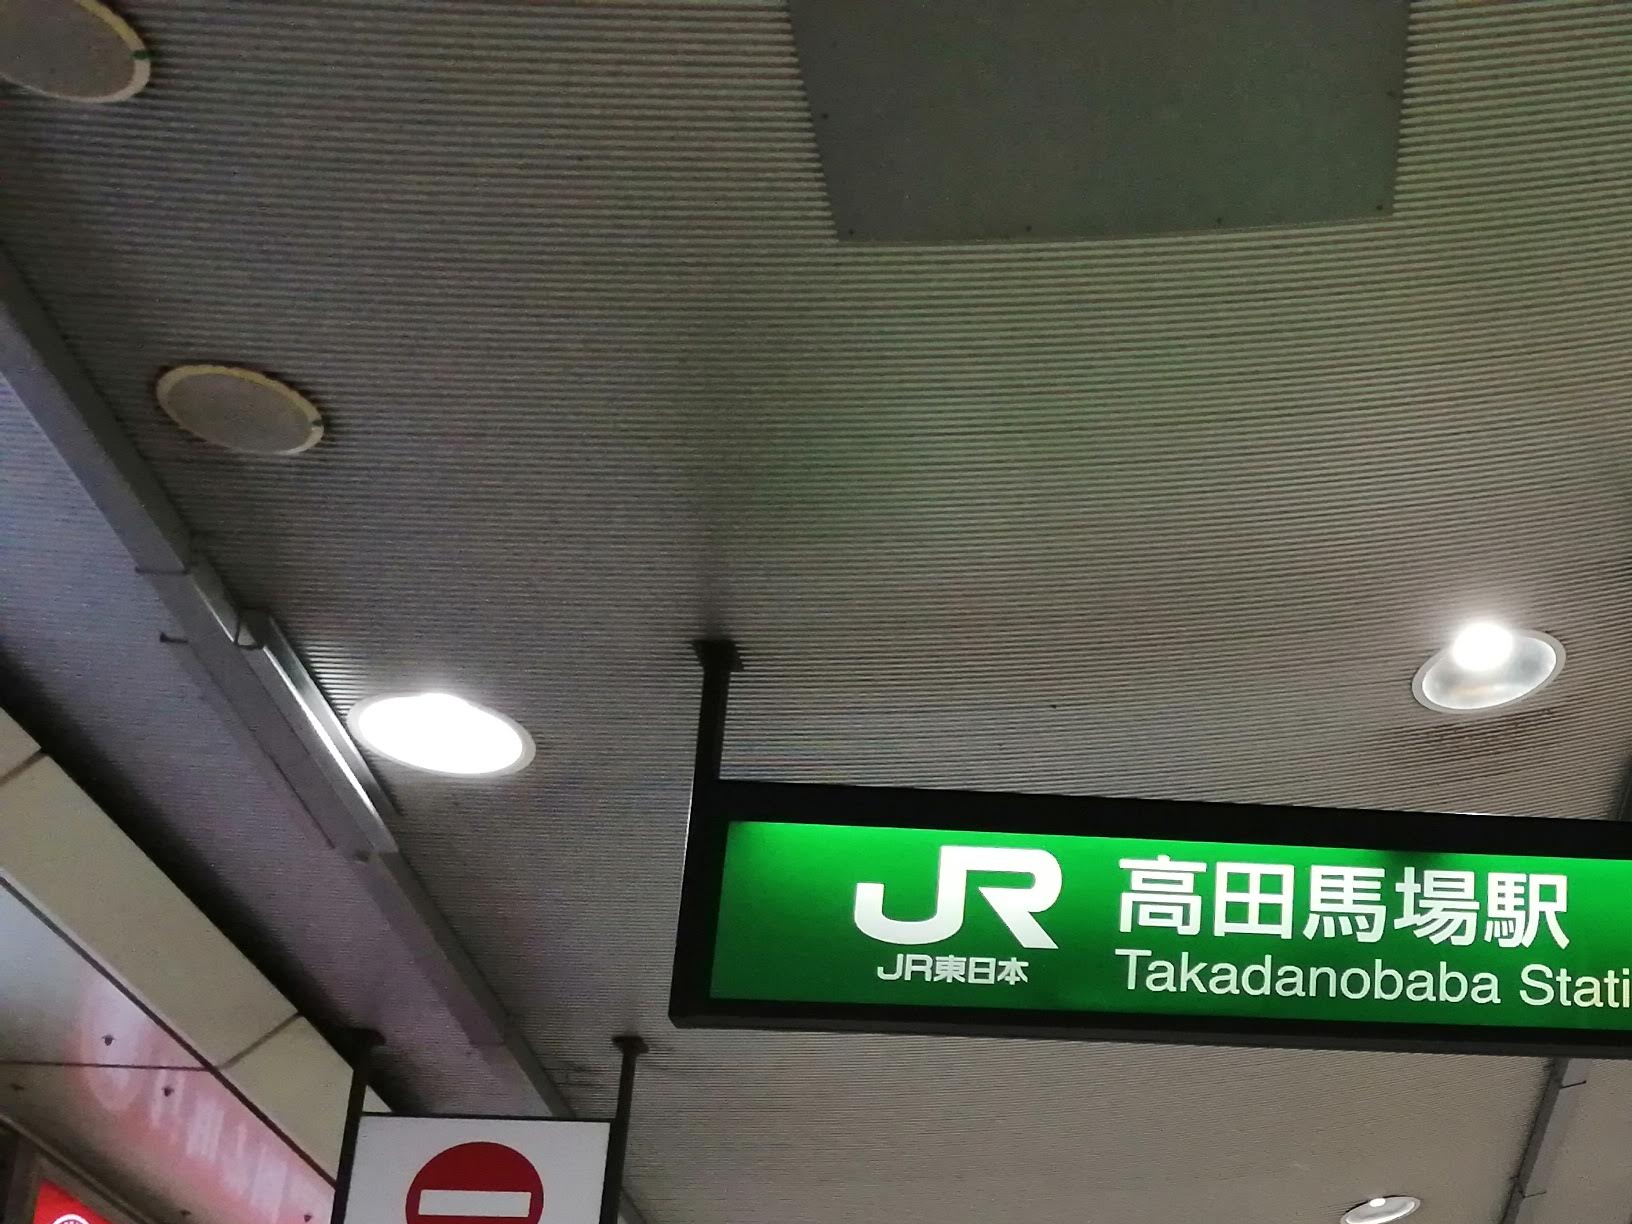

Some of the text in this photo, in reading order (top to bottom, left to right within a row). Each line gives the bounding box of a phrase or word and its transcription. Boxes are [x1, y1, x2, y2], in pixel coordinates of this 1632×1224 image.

[854, 845, 1063, 950] JR
[1118, 855, 1571, 950] 高田馬場駅
[877, 953, 1030, 986] JR東日本
[1115, 948, 1502, 1005] Takadanobaba
